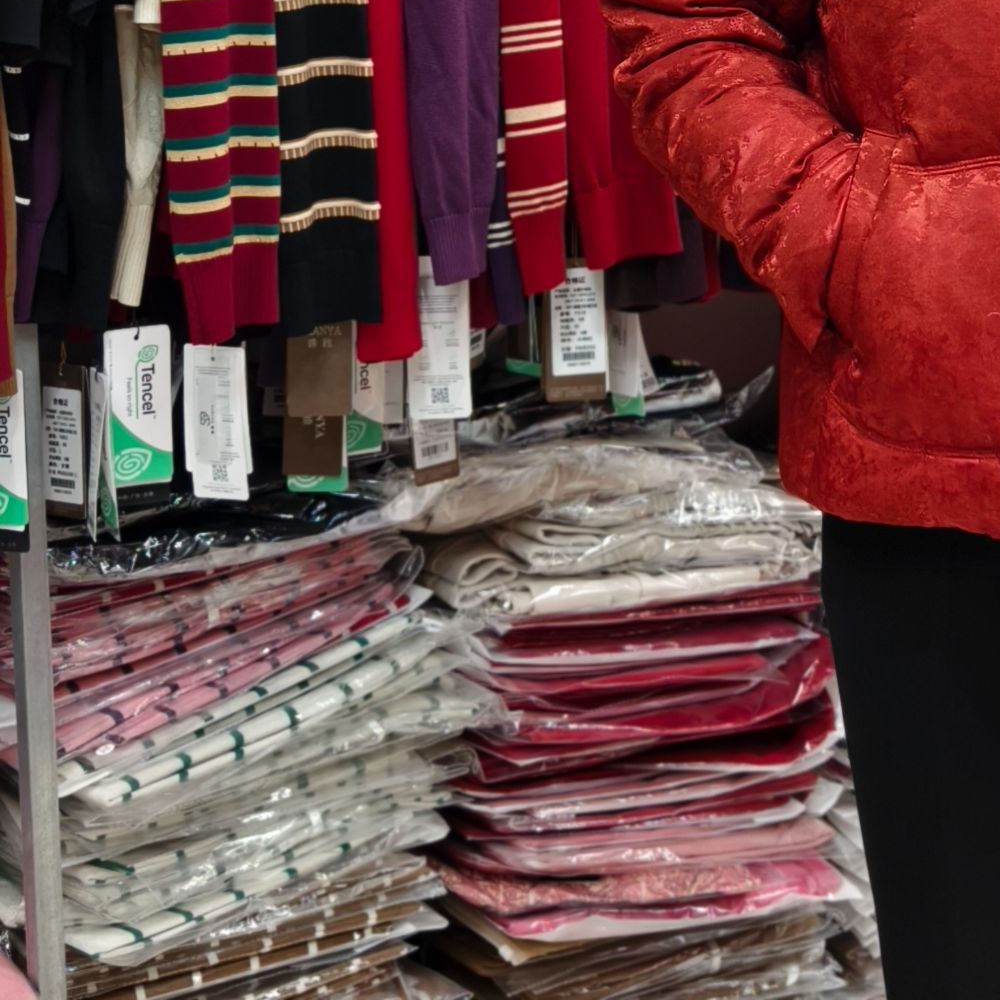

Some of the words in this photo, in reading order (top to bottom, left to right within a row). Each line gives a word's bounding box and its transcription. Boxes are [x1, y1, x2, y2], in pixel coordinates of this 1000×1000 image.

[141, 363, 156, 415] Tencel
[360, 363, 372, 391] ncel
[0, 405, 12, 458] Tencel
